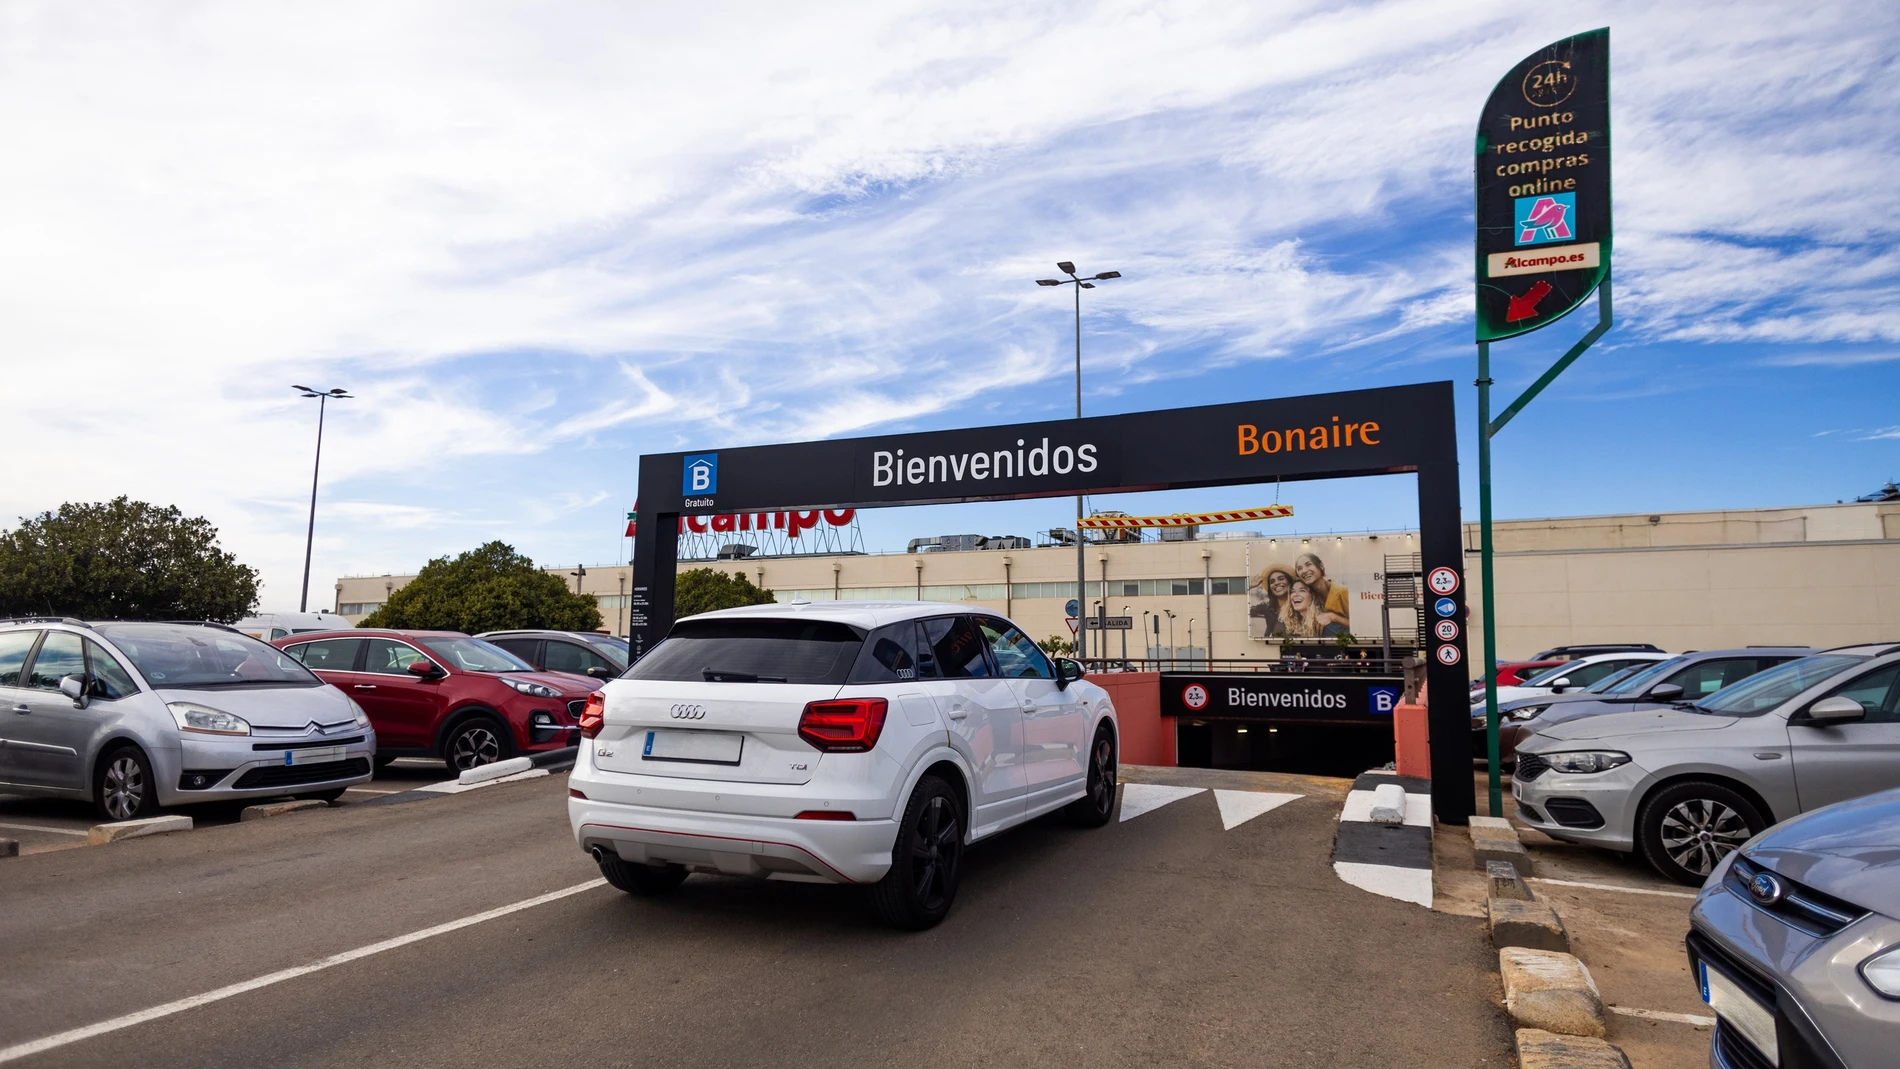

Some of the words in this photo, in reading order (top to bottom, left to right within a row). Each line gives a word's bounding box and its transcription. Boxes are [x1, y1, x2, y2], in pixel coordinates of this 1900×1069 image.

[1532, 68, 1568, 89] 24h
[1511, 112, 1574, 131] Punto
[1497, 130, 1588, 154] recogida
[1496, 153, 1589, 175] compras
[1508, 178, 1576, 197] online
[1237, 416, 1380, 456] Bonaire
[873, 437, 1098, 487] Bienvenidos
[685, 498, 714, 508] Gratuito
[1228, 688, 1347, 709] Bienvenidos
